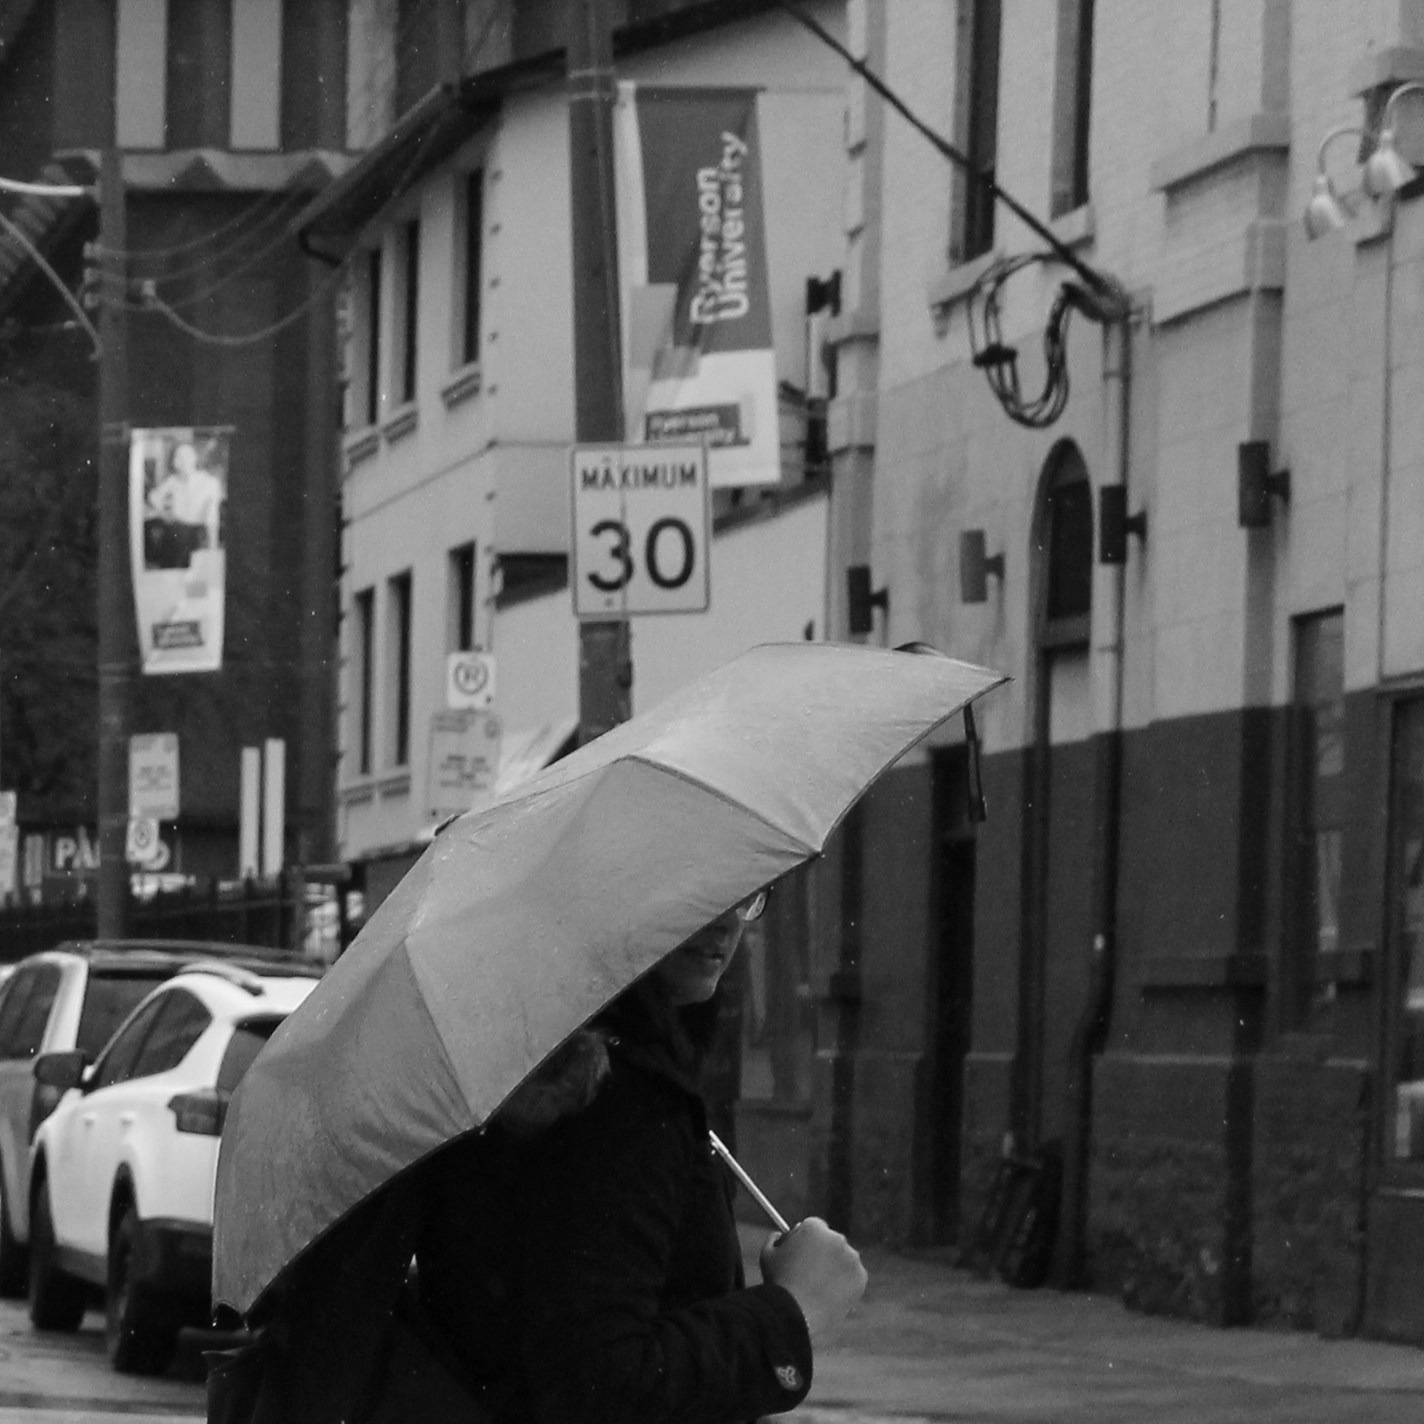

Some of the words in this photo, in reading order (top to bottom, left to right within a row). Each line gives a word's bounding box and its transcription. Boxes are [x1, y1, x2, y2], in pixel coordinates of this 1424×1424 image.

[718, 131, 750, 319] University
[581, 463, 697, 490] MAXIMUM
[587, 515, 696, 591] 30
